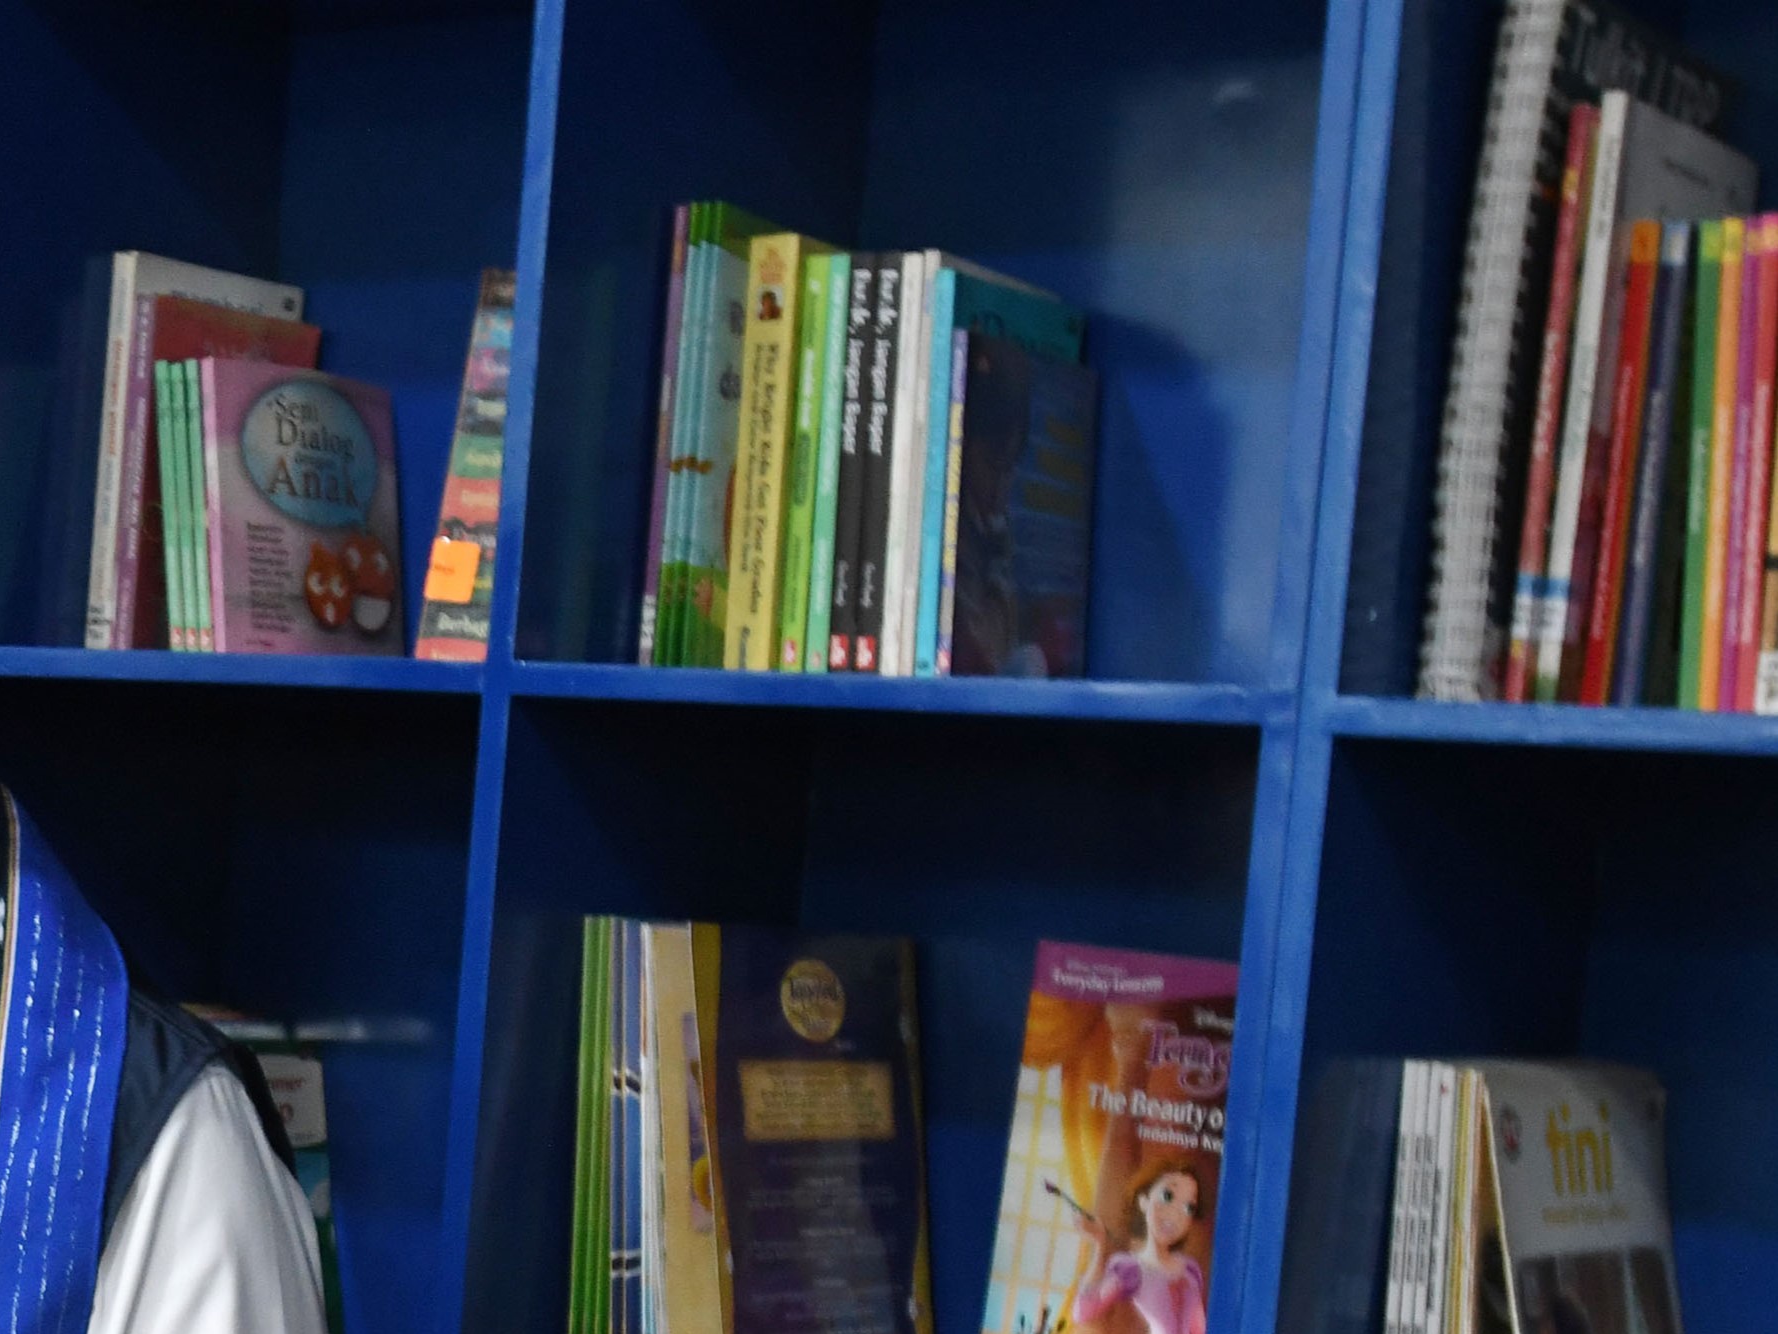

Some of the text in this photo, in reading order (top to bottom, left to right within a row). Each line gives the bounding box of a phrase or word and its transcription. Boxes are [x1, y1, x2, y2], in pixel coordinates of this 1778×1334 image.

[275, 414, 355, 464] Dialog
[267, 456, 360, 508] Anak
[1088, 1082, 1127, 1116] The
[1129, 1087, 1207, 1134] Beauty
